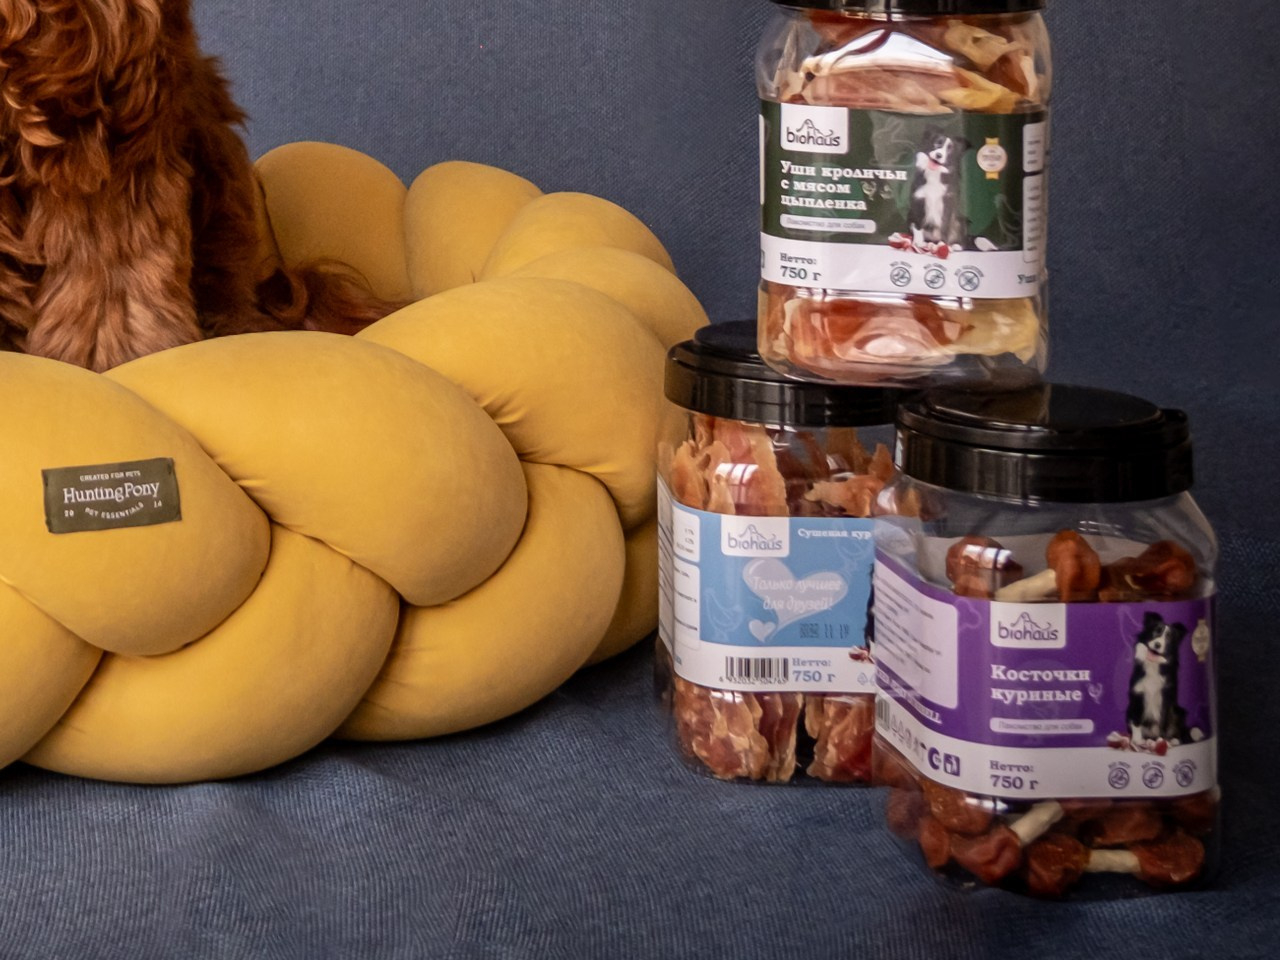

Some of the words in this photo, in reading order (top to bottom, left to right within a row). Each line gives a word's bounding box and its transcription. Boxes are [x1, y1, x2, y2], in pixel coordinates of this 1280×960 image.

[786, 127, 840, 147] biohaus
[780, 160, 816, 176] Уши
[821, 167, 907, 181] кроличьи
[780, 179, 790, 189] с
[793, 181, 851, 194] мясом
[780, 194, 867, 211] цыпленка
[780, 253, 817, 265] Нетто:
[780, 265, 808, 281] 750
[812, 271, 822, 281] г
[80, 473, 109, 481] CREATED
[125, 470, 141, 478] PETS
[101, 502, 144, 519] ESSENTIALS
[728, 532, 783, 551] biohaus
[797, 528, 849, 539] Сушеная
[851, 529, 872, 540] кур
[998, 621, 1058, 641] biohaus
[792, 658, 832, 667] Нетто:
[792, 670, 822, 683] 750
[827, 671, 836, 683] г
[990, 664, 1091, 682] Косточки
[990, 687, 1083, 705] куриные
[990, 760, 1034, 773] Нетто:
[990, 774, 1023, 789] 750
[1029, 779, 1039, 790] г
